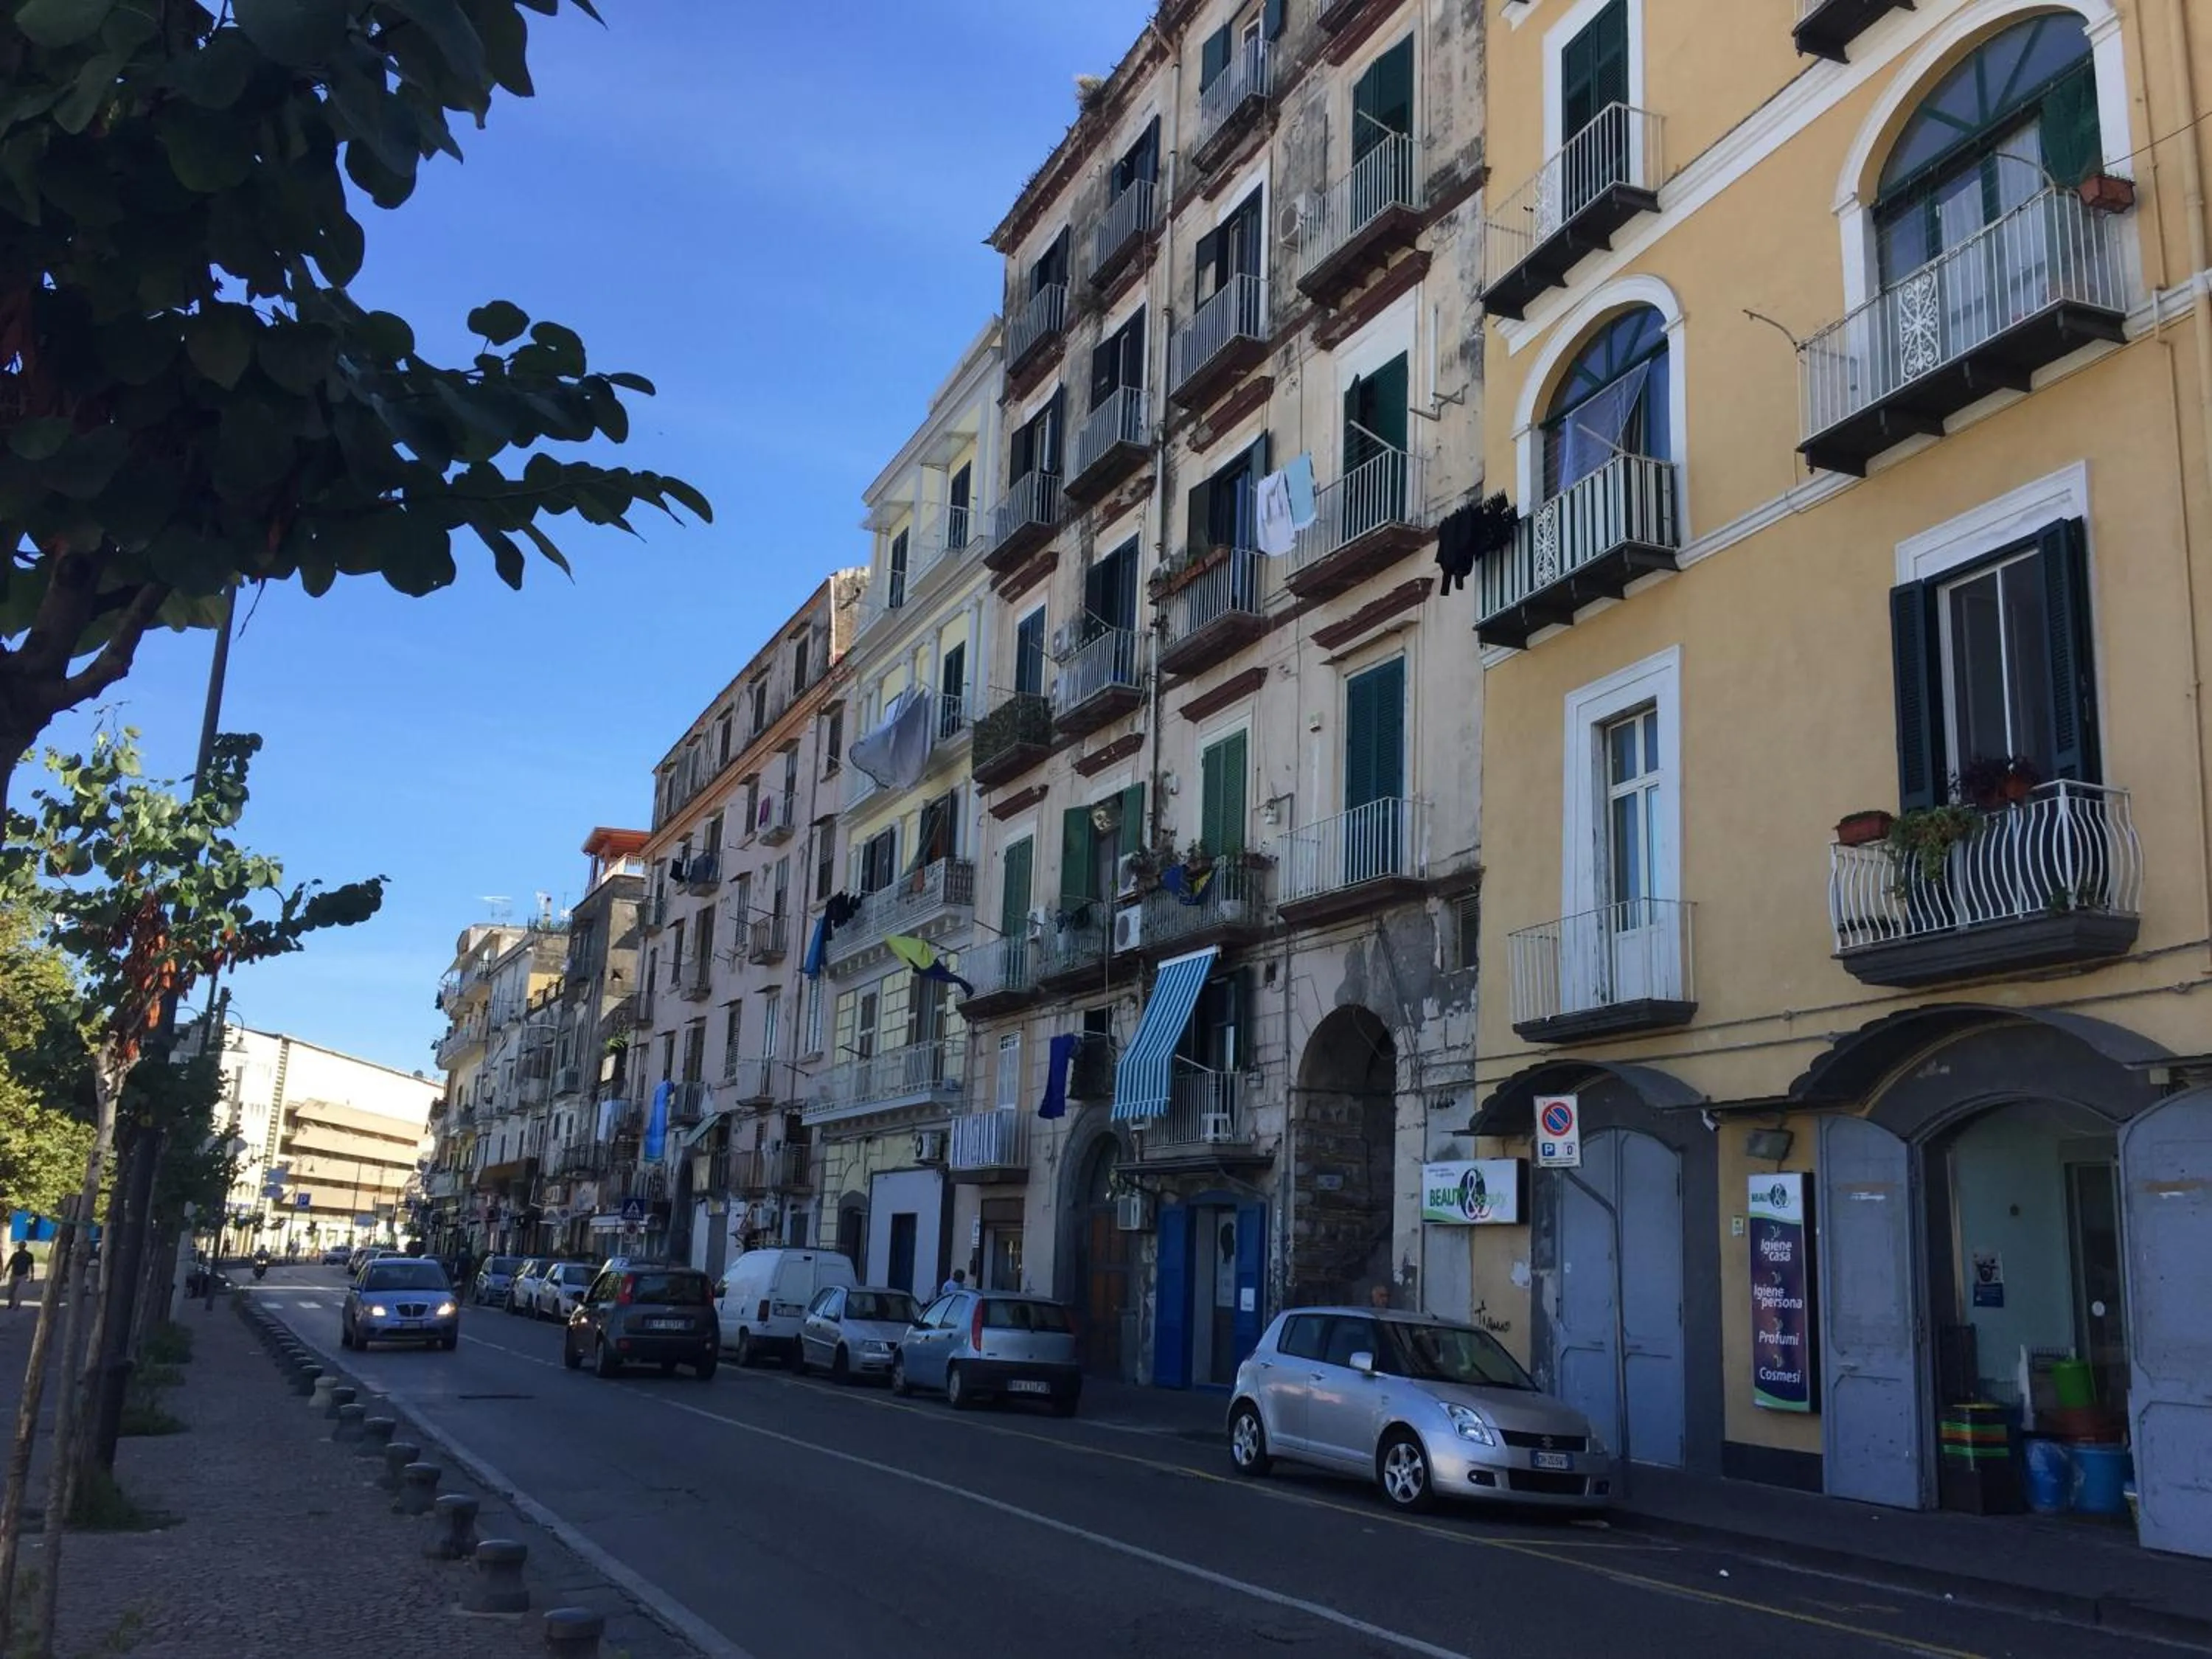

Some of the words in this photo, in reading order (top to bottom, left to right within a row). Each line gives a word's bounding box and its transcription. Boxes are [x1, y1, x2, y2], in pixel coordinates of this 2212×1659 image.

[1760, 1237, 1792, 1253] Igiene
[1769, 1250, 1790, 1262] casa
[1753, 1284, 1784, 1300] Igiene
[1761, 1295, 1802, 1310] persona
[1759, 1330, 1799, 1346] Profumi
[1759, 1366, 1801, 1383] Cosmesi
